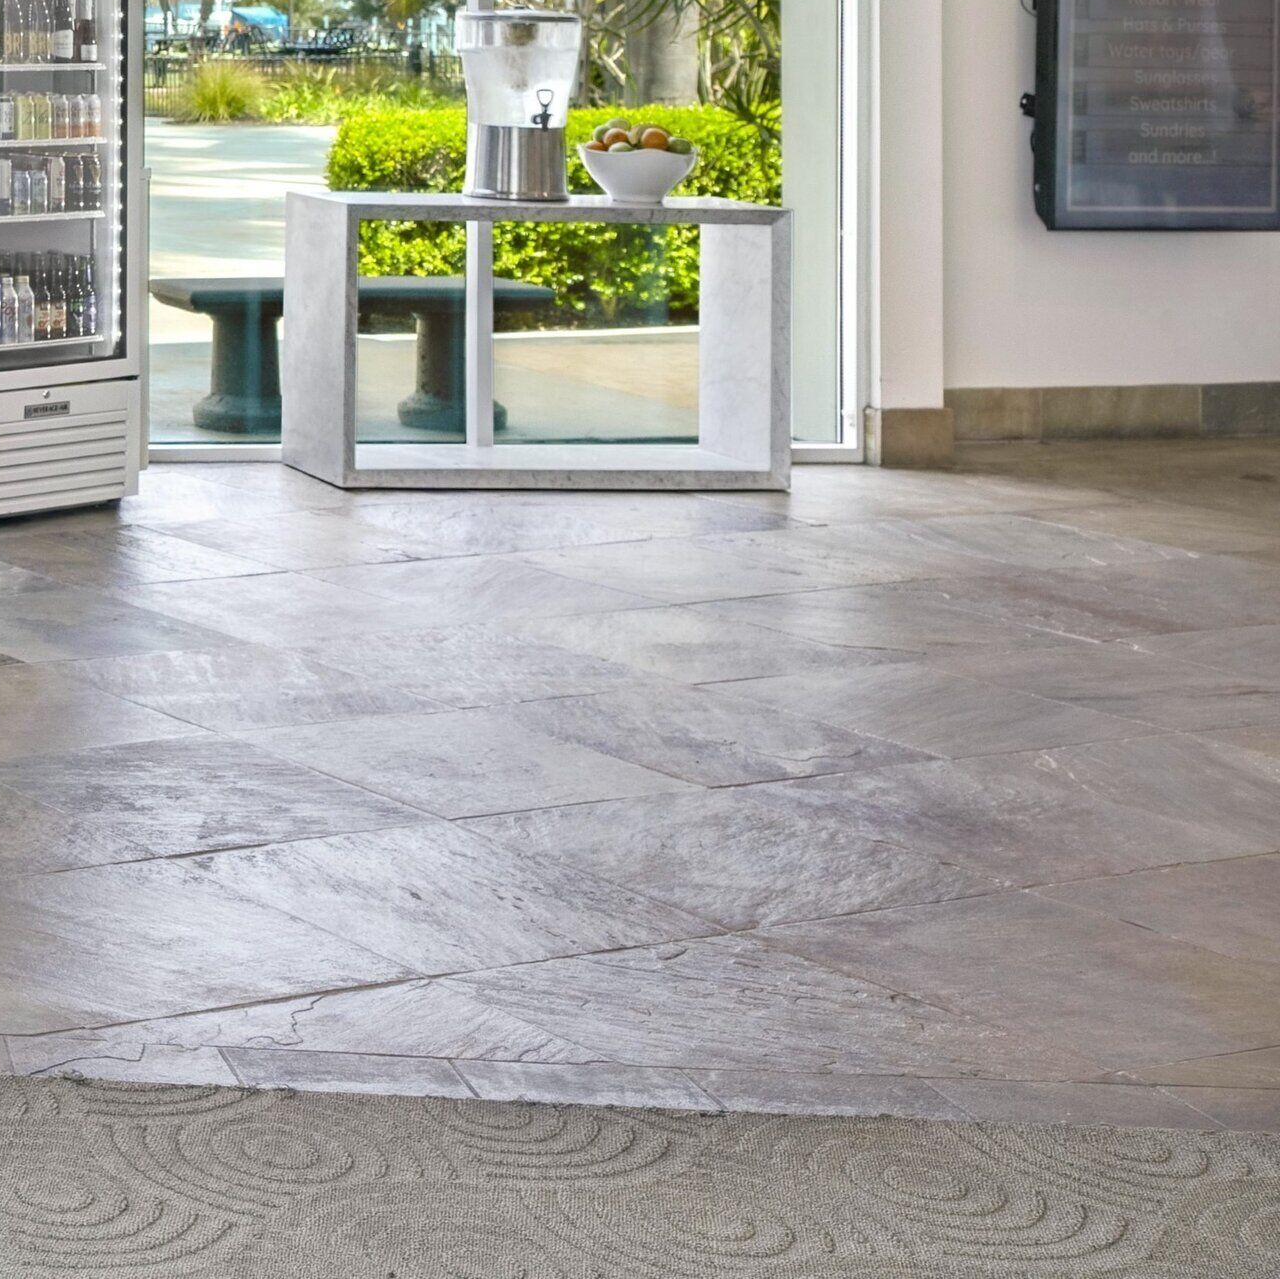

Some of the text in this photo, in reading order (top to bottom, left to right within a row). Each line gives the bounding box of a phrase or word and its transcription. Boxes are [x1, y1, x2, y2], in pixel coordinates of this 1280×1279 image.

[1122, 18, 1157, 33] Hats
[1177, 18, 1228, 34] Purses
[1107, 41, 1154, 59] Water
[1134, 71, 1218, 88] Sunglasses
[1130, 96, 1217, 112] Sweatshirts
[1140, 122, 1206, 138] Sundries
[1128, 148, 1158, 165] and
